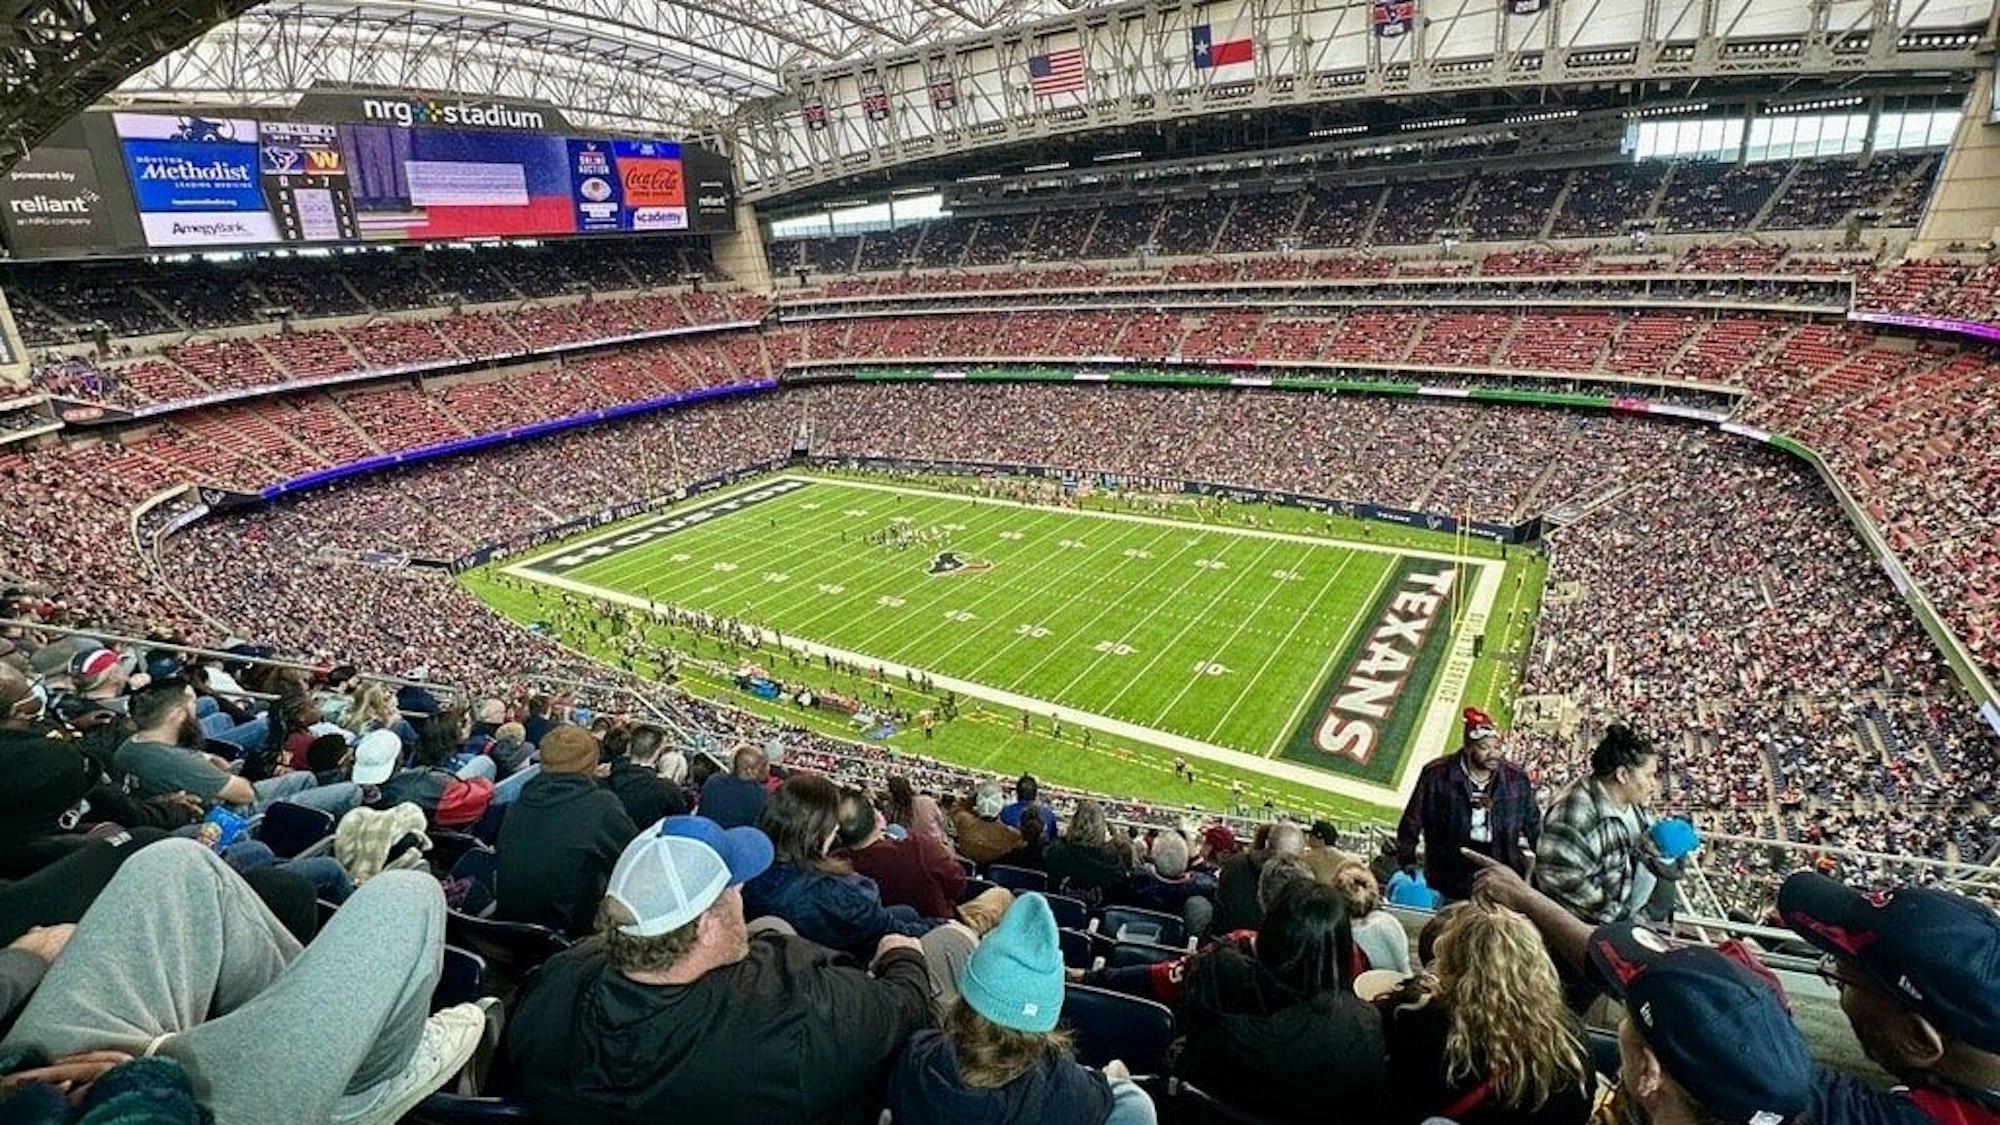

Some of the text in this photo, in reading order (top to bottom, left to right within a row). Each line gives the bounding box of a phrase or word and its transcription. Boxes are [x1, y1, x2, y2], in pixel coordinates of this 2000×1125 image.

[363, 98, 544, 129] nrg stadium
[140, 161, 250, 181] Methodist
[10, 195, 90, 213] reliant
[1315, 567, 1458, 766] TEXANS
